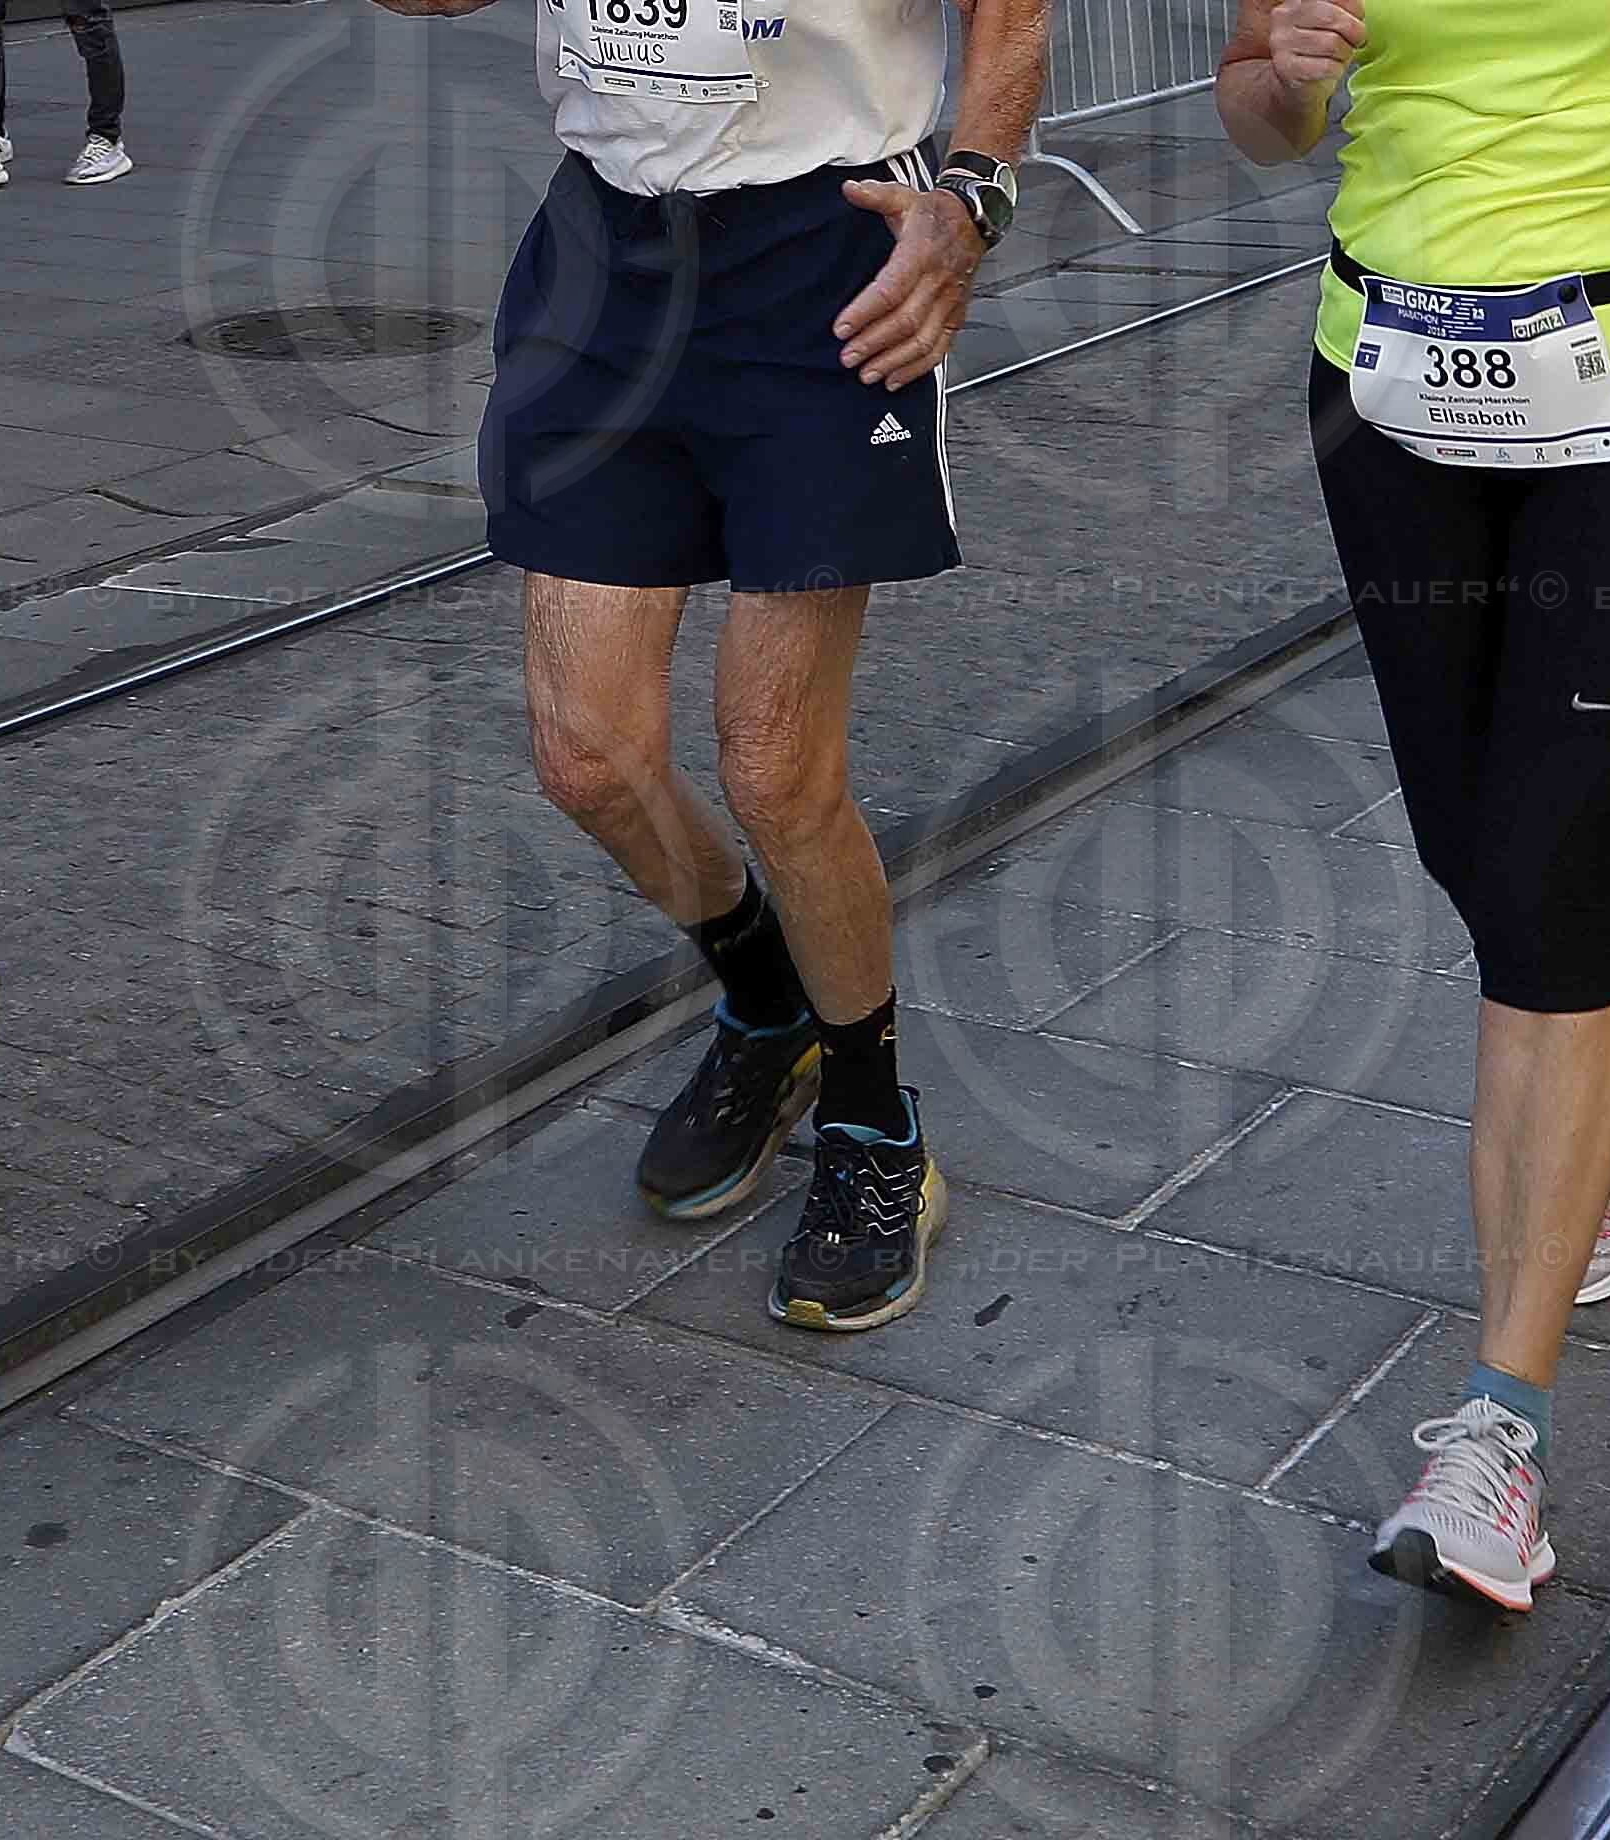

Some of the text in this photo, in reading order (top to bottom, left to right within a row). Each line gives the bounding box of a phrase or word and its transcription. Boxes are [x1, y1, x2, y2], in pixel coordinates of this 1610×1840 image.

[589, 36, 666, 66] JULIUS
[1406, 290, 1453, 315] GRAZ
[1397, 308, 1439, 326] MARATHON
[1423, 344, 1517, 389] 388
[870, 429, 912, 445] adidas
